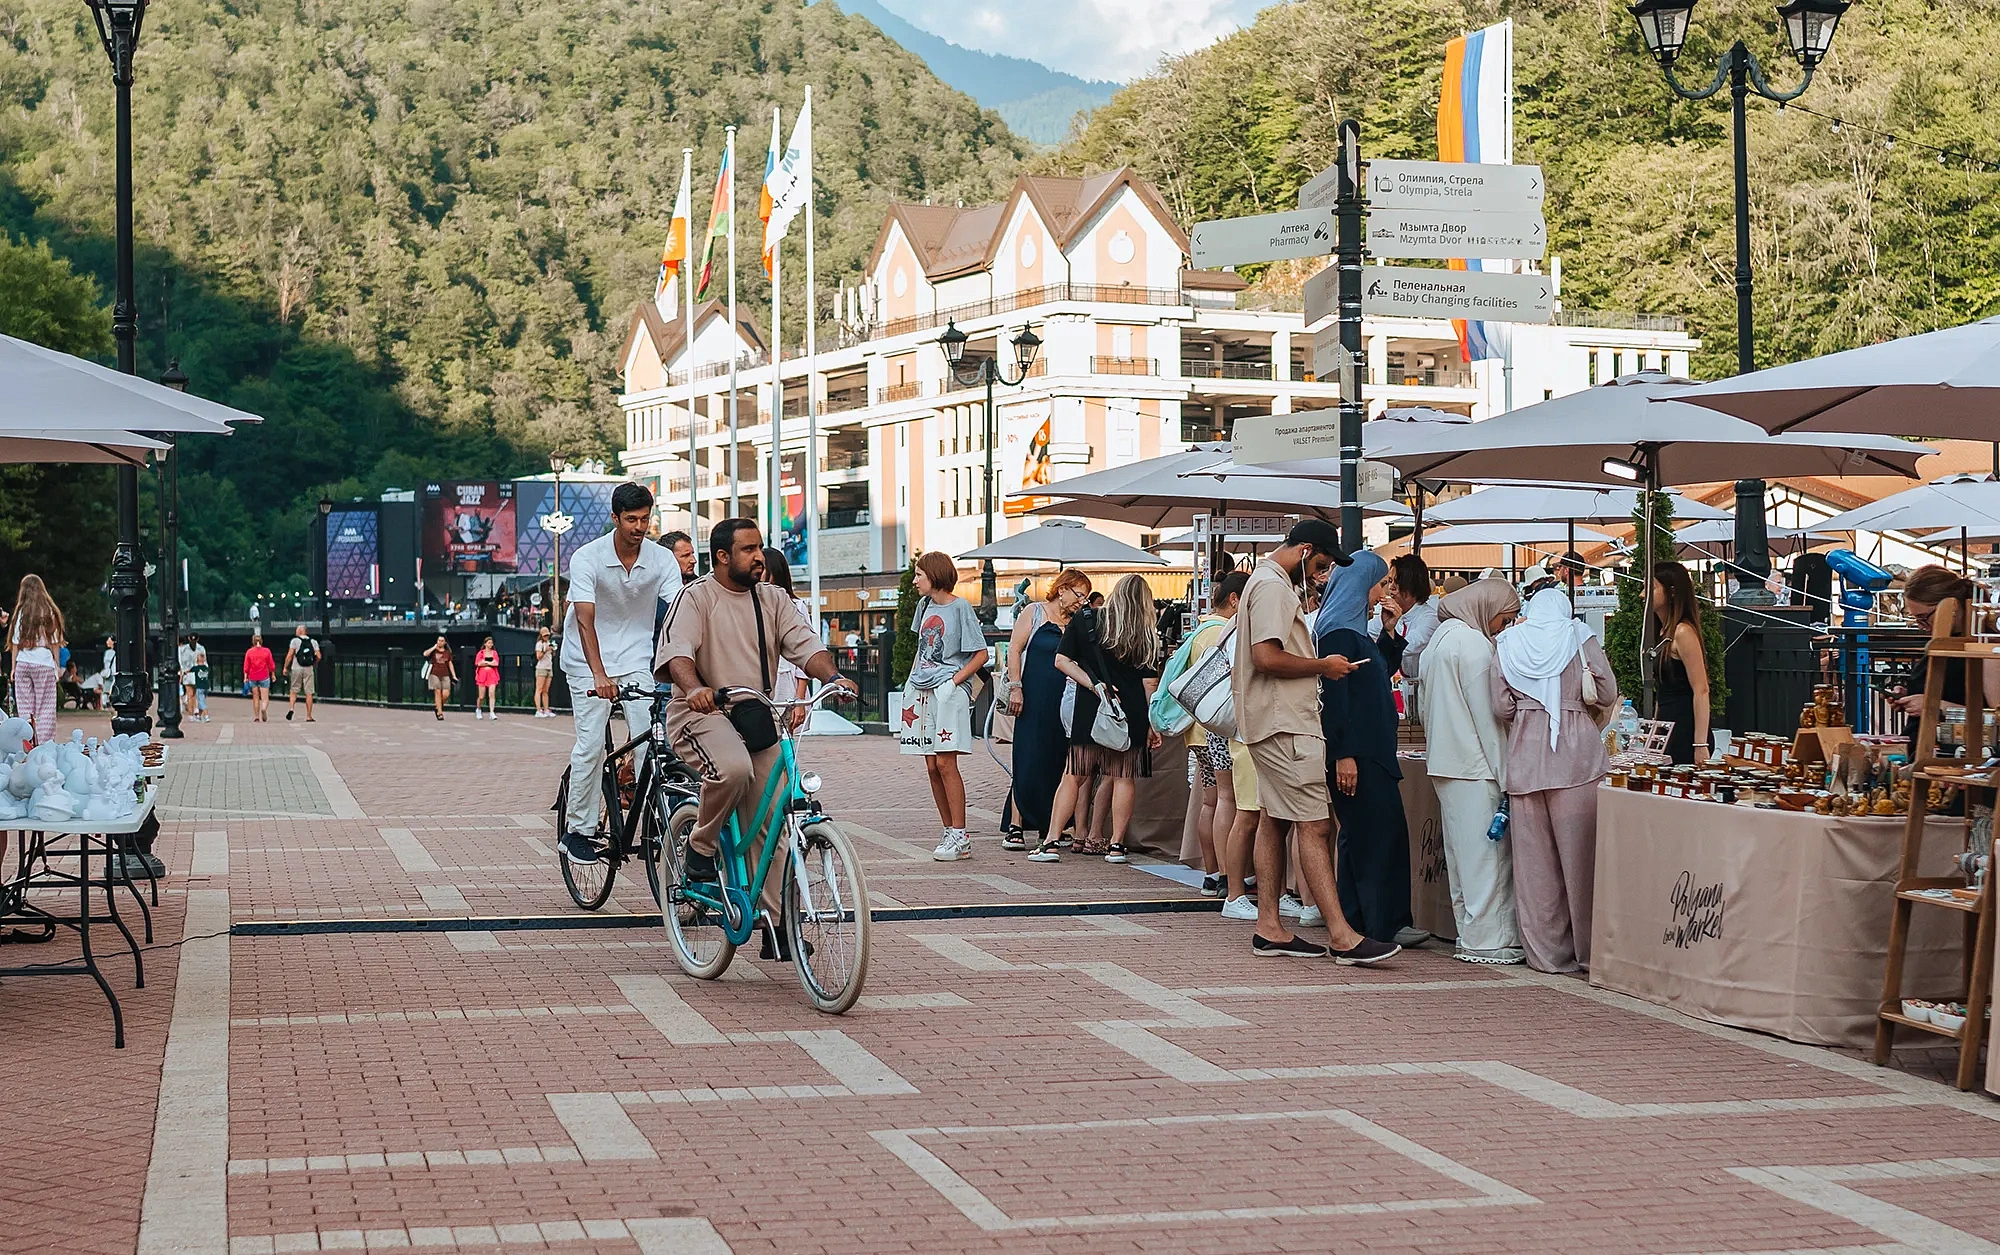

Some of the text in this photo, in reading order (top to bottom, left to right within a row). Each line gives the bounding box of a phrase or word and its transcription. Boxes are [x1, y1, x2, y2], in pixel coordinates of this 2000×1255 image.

[1398, 173, 1484, 186] Олимпия, Стрела
[1398, 185, 1473, 197] Olympia, Strela
[1280, 222, 1310, 235] Аптека
[1400, 222, 1467, 234] Мзымта Двор
[1270, 235, 1310, 248] Pharmacy
[1400, 235, 1462, 246] Mzymta Dvor
[1393, 280, 1466, 293] Пеленальная
[1393, 292, 1518, 309] Baby Changing facilities
[1274, 423, 1335, 436] Продажа апартаментов
[1293, 434, 1335, 446] VALSET Premium
[457, 485, 485, 496] CUBAN
[460, 495, 481, 505] JAZZ
[1670, 870, 1724, 923] Polyana
